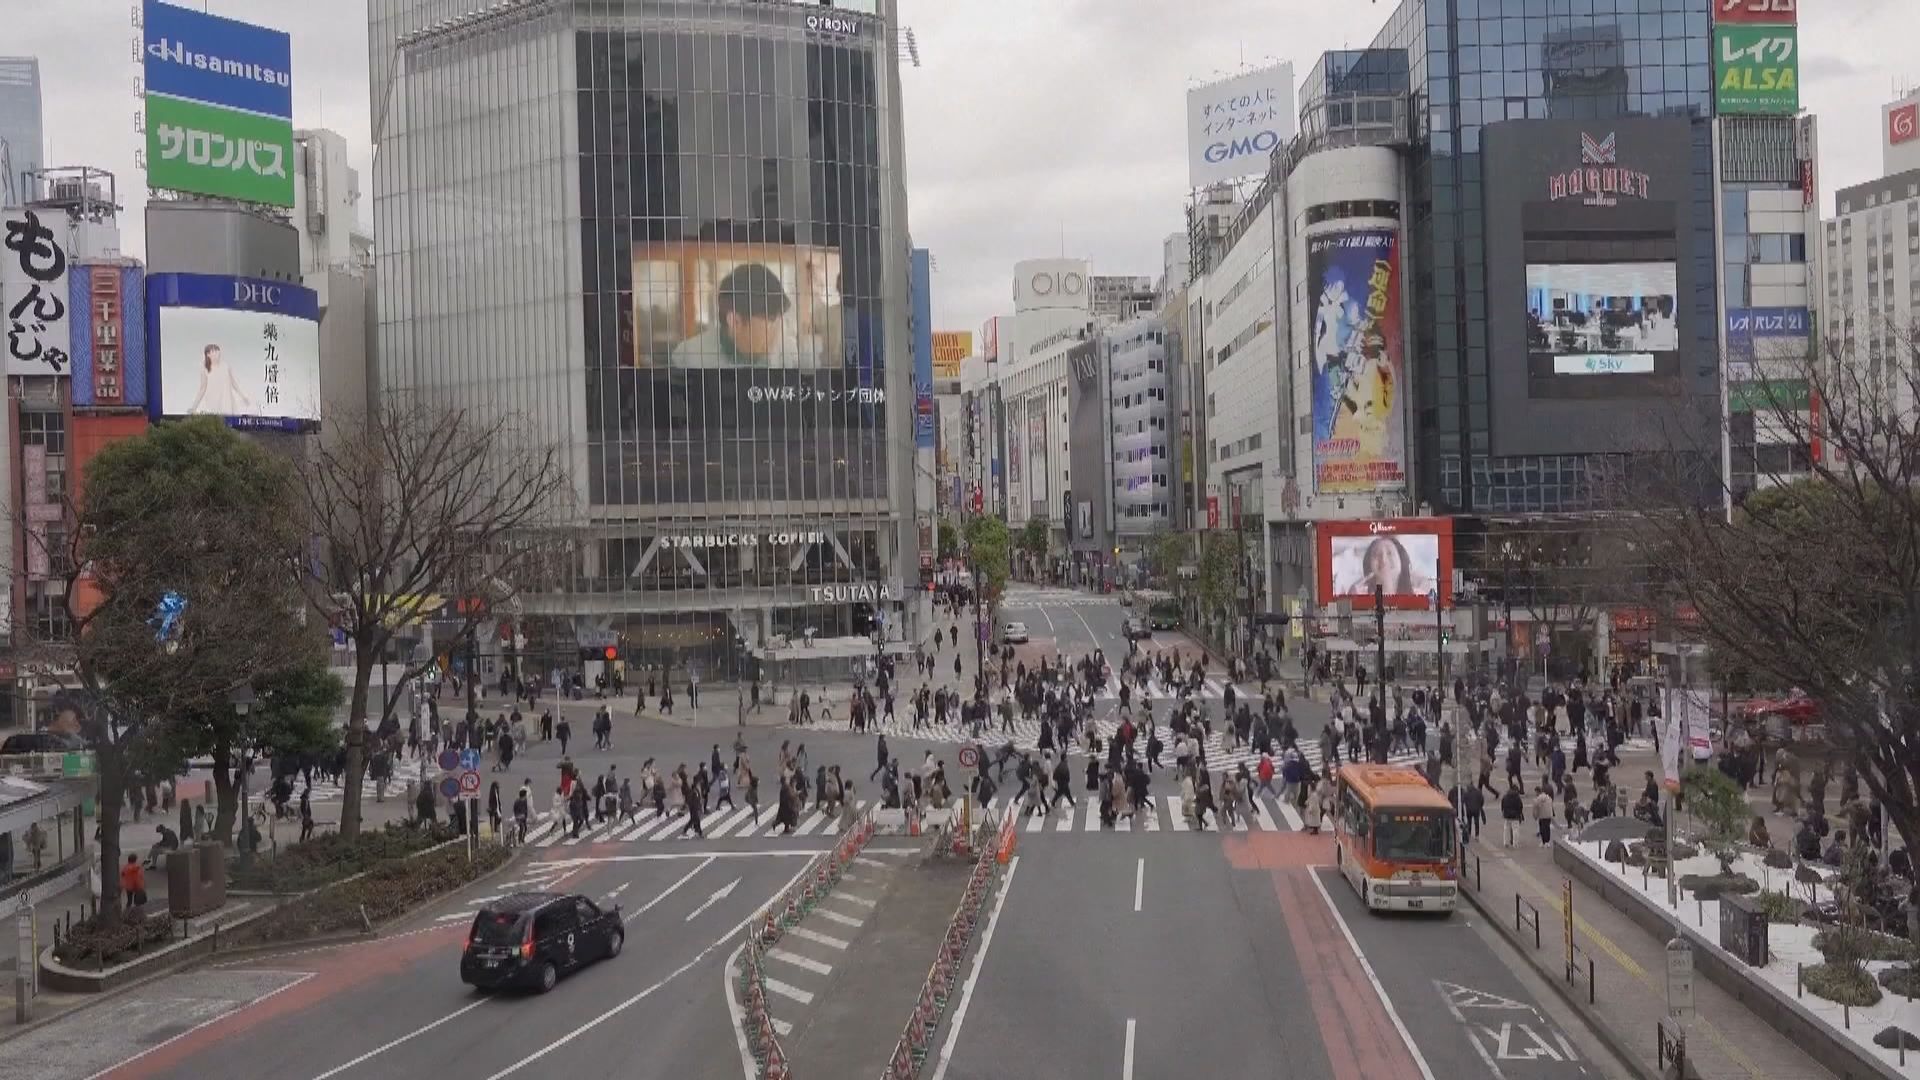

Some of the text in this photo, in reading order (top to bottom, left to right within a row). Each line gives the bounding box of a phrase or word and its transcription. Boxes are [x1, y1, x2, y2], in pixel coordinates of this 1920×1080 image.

[148, 38, 289, 87] Hisamitsu
[1722, 36, 1794, 63] レイク
[1721, 68, 1795, 91] ALSA
[1204, 105, 1277, 137] インターネット
[157, 123, 286, 179] サロンパス
[1204, 130, 1278, 163] GMO
[1550, 168, 1650, 201] MAGNET
[5, 210, 68, 372] もんじゃ
[233, 282, 281, 305] DHC
[661, 531, 825, 549] STARBUCKS COFFEE
[811, 583, 890, 602] TSUTAYA
